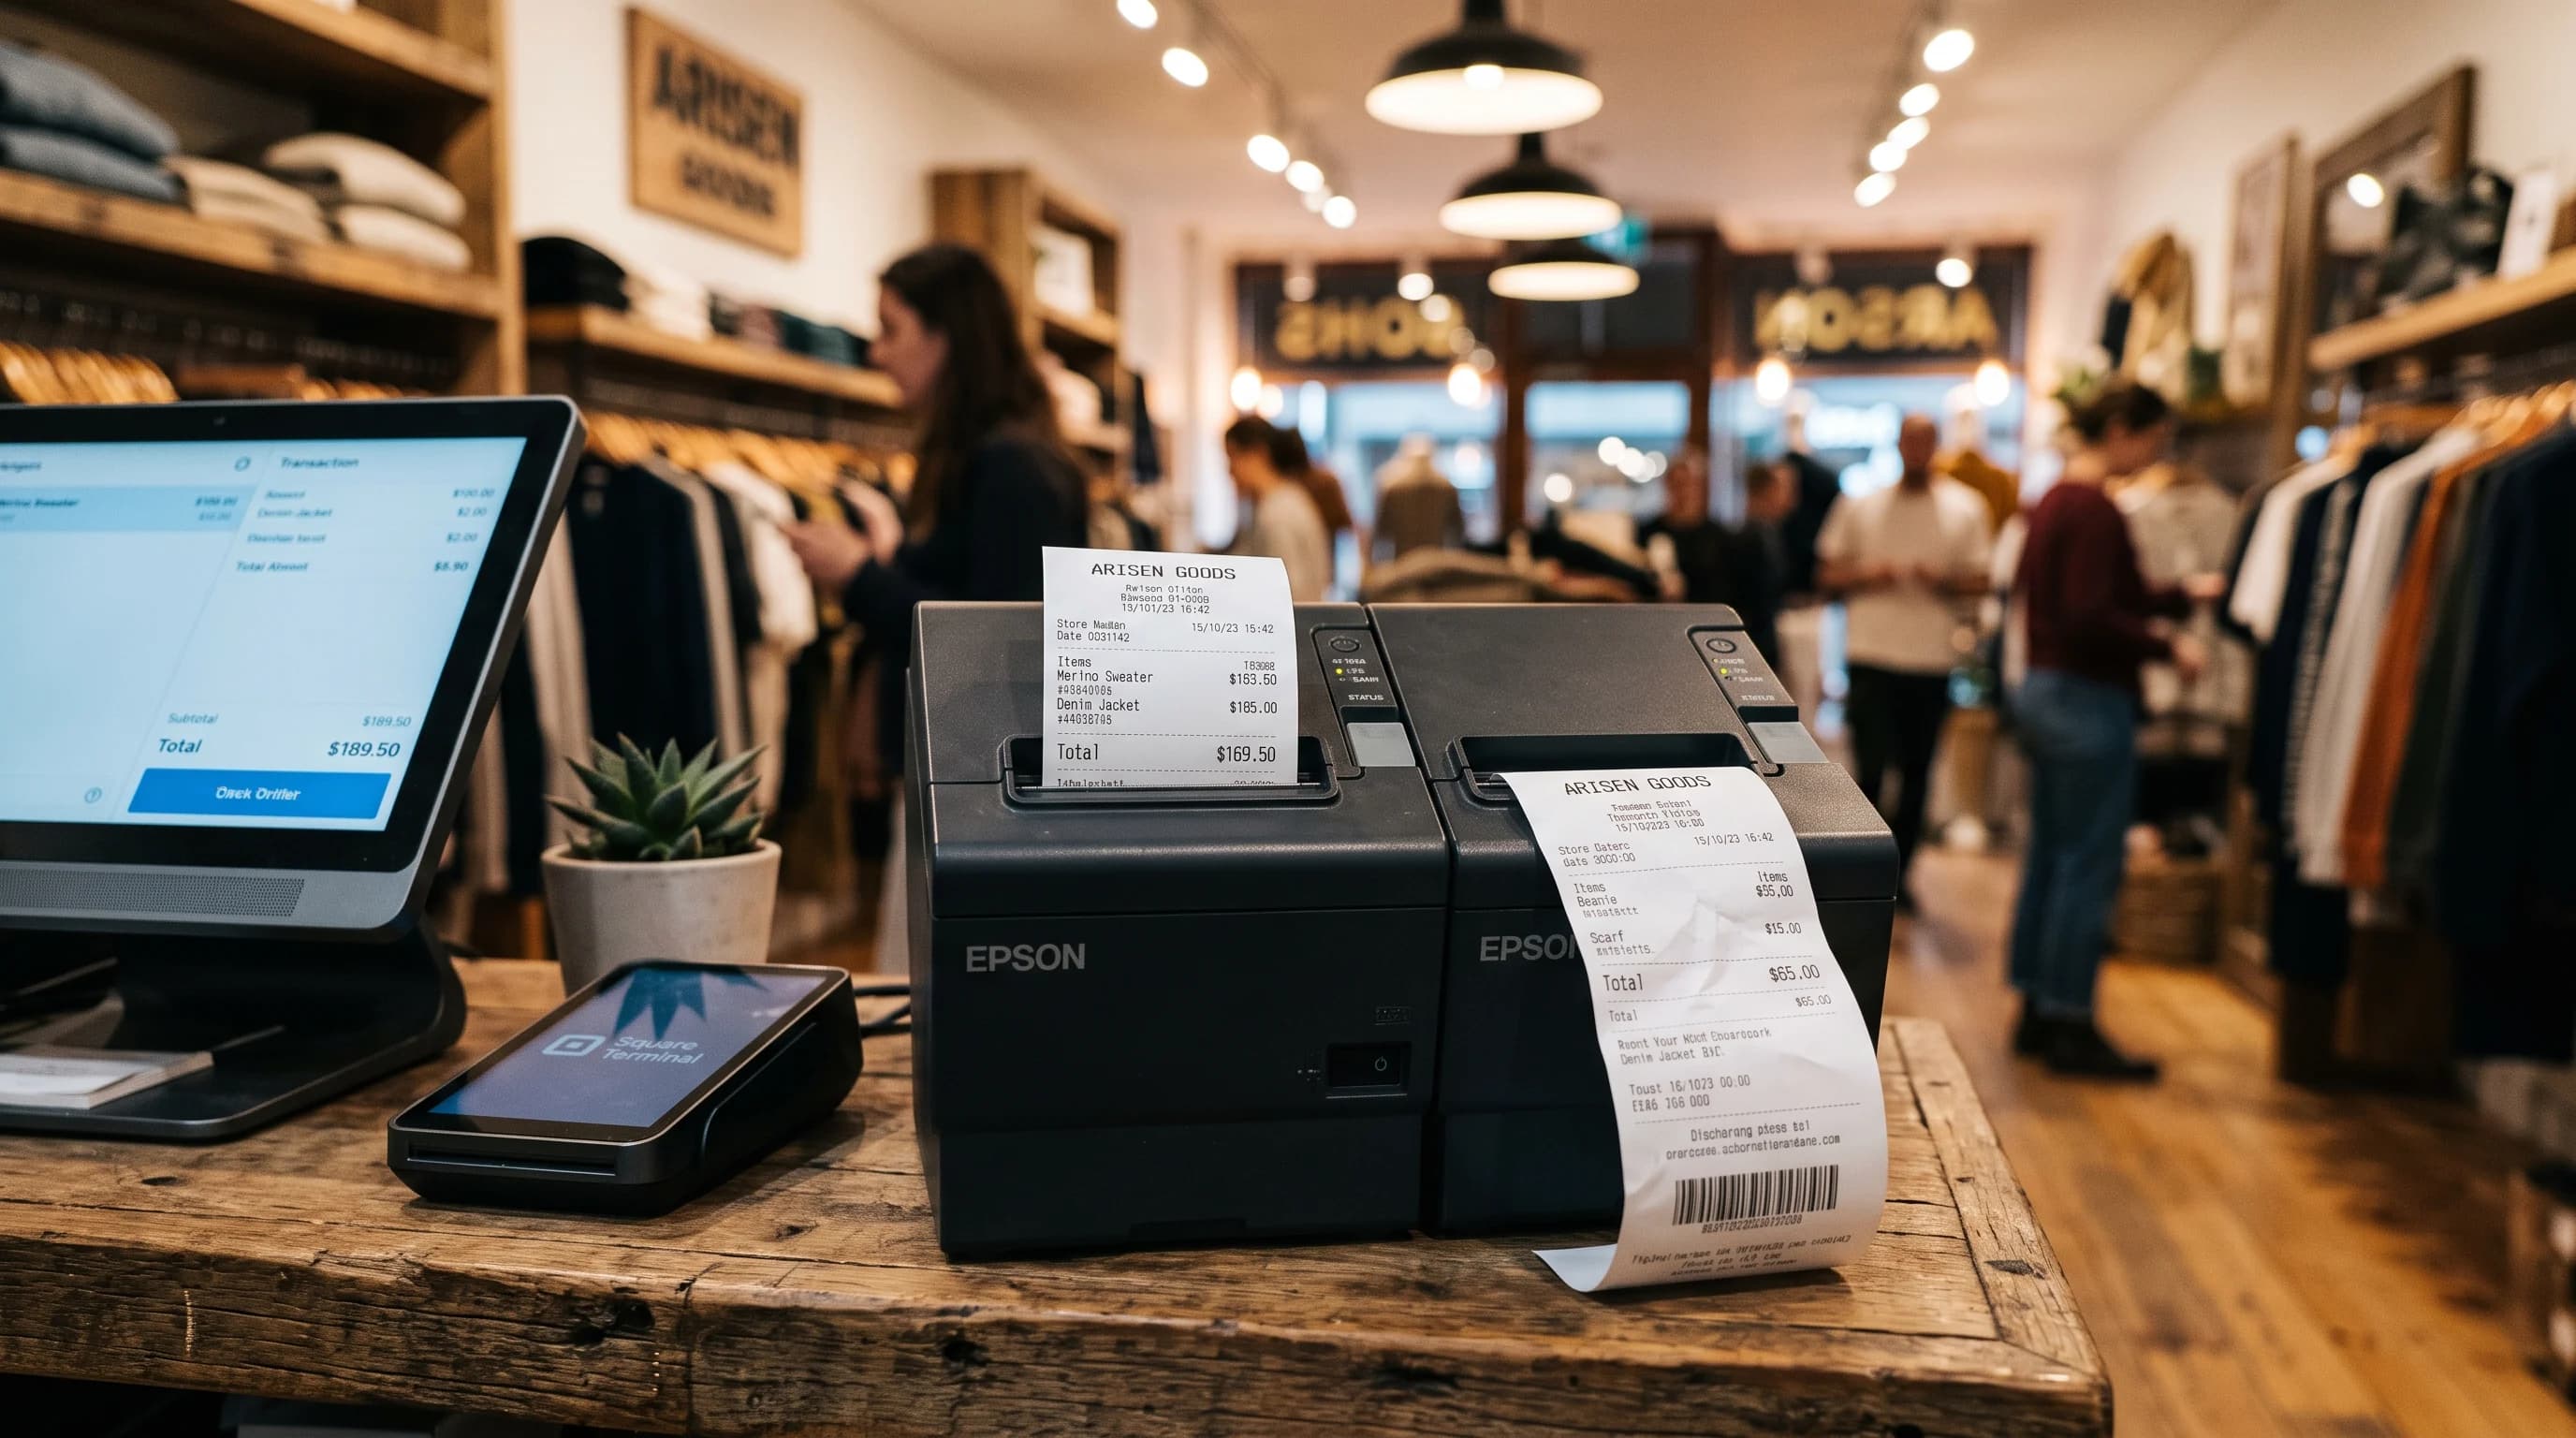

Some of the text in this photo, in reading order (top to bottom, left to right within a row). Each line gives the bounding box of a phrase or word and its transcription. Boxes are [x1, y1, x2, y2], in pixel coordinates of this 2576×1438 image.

[281, 456, 359, 468] Transaction
[1091, 564, 1236, 580] ARISEN GOODS
[1181, 605, 1209, 614] 16:42
[1058, 619, 1088, 629] Store
[1193, 623, 1238, 633] 15/10/23
[1245, 624, 1274, 634] 15:42
[1058, 631, 1082, 640] Date
[1058, 656, 1091, 667] Items
[1058, 670, 1098, 682] Merino
[1105, 671, 1153, 682] Sweater
[1058, 698, 1278, 713] Denim Jacket $185.00
[168, 712, 412, 727] Subtotal $189.50
[158, 738, 401, 757] Total $189.50
[1058, 743, 1276, 762] Total $169.50
[1565, 776, 1711, 795] ARISEN GOODS
[1559, 844, 1589, 855] Store
[1694, 834, 1740, 845] 15/10/23
[1745, 832, 1774, 843] 16:42
[1574, 883, 1606, 894] Items
[1578, 895, 1617, 907] Beanie
[1590, 923, 1801, 944] Scarf $15.00
[966, 943, 1086, 972] EPSON
[1603, 964, 1820, 991] Total $65.00
[1608, 994, 1831, 1022] Total $65.00
[614, 1035, 697, 1051] Square
[1654, 1035, 1678, 1047] Your
[603, 1049, 704, 1064] Terminal
